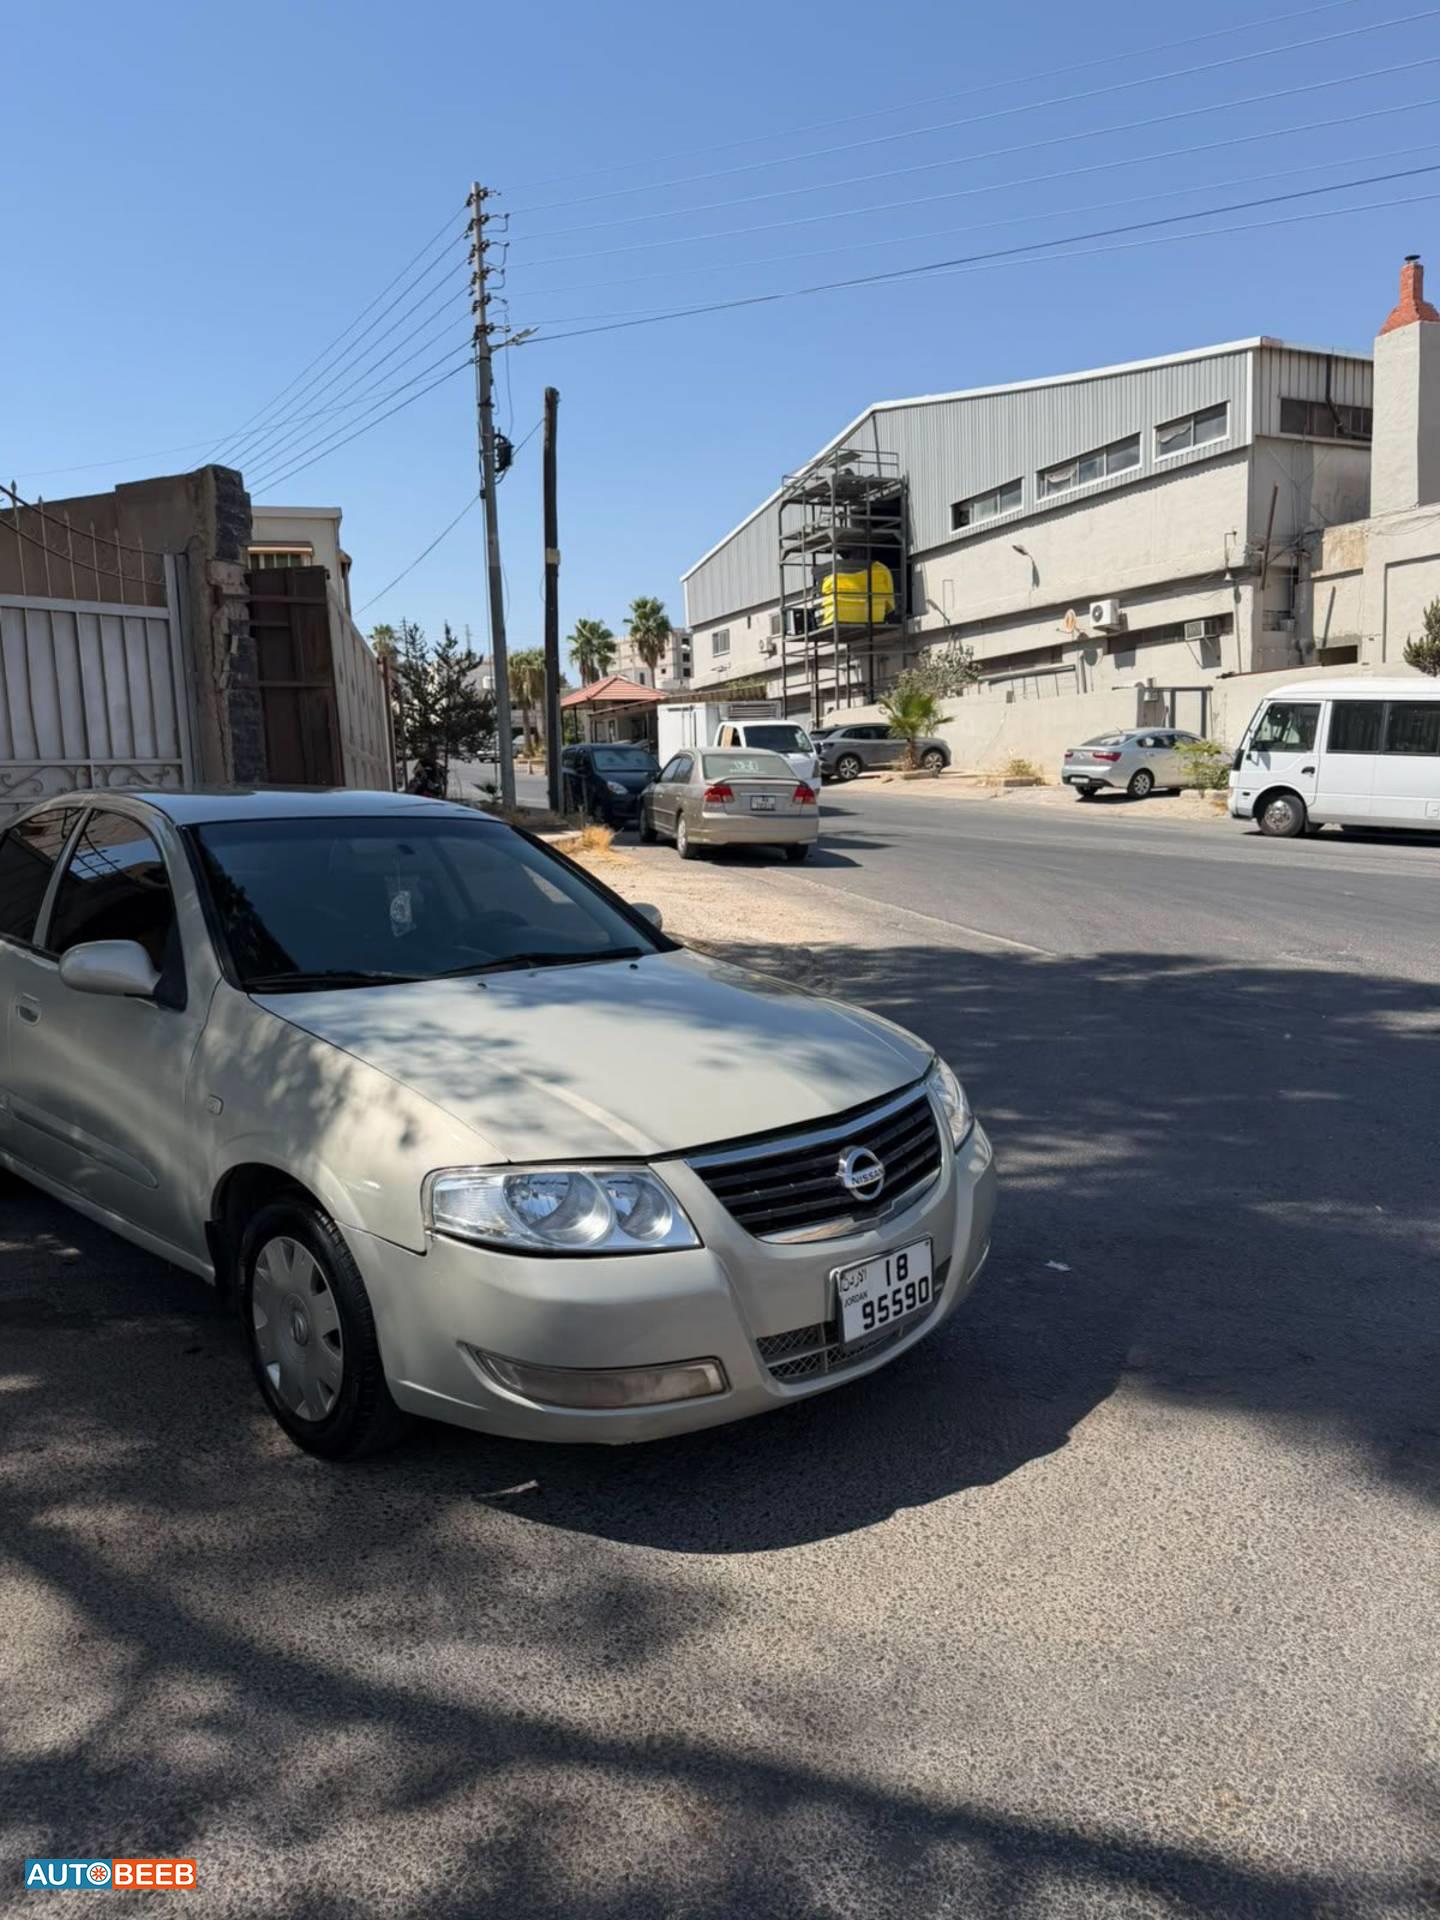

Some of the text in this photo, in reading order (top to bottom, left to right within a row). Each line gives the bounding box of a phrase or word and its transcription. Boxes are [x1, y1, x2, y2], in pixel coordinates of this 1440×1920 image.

[885, 1253, 908, 1287] 18
[844, 1290, 868, 1308] JORDAN
[862, 1276, 930, 1330] 95590
